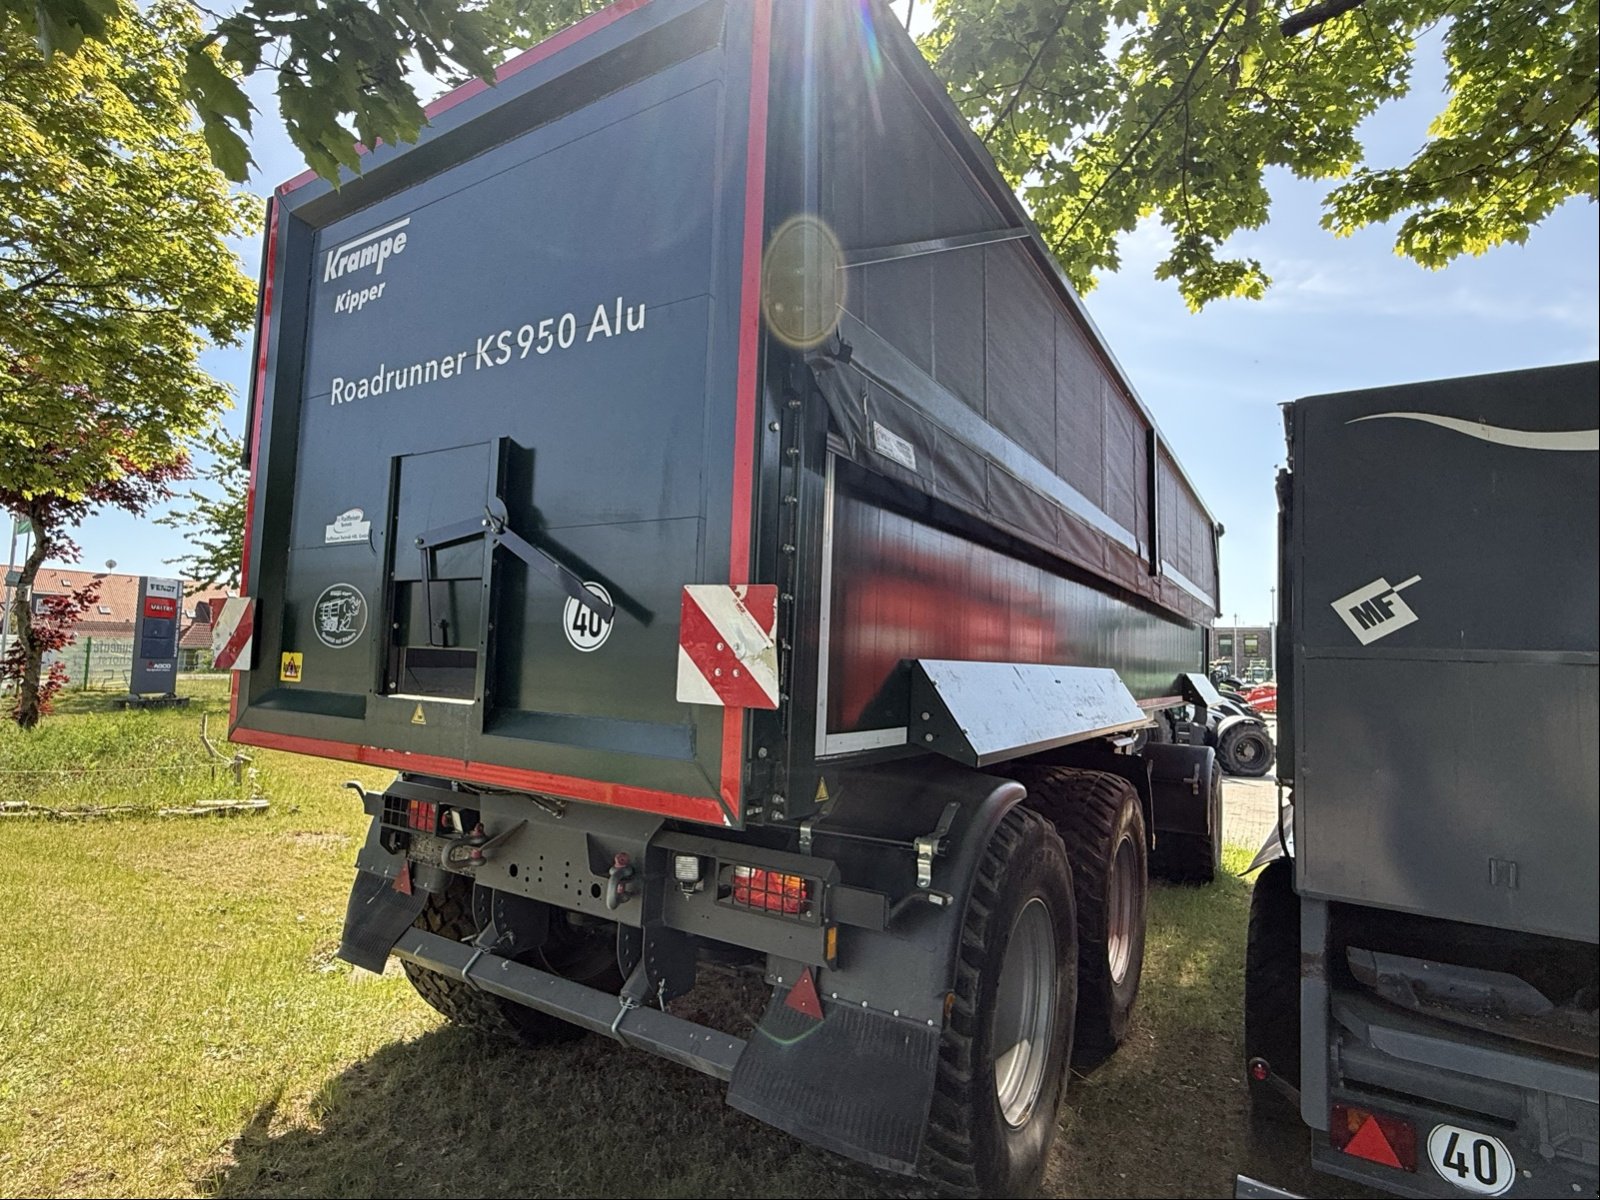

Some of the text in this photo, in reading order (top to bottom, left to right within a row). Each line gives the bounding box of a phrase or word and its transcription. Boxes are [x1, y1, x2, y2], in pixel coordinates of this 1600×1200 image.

[323, 218, 410, 283] Krampe
[334, 281, 386, 314] Kipper
[330, 350, 467, 406] Roadrunner
[586, 296, 646, 342] Alu
[572, 600, 603, 638] 40
[1349, 588, 1395, 630] MF
[1442, 1131, 1498, 1186] 40
